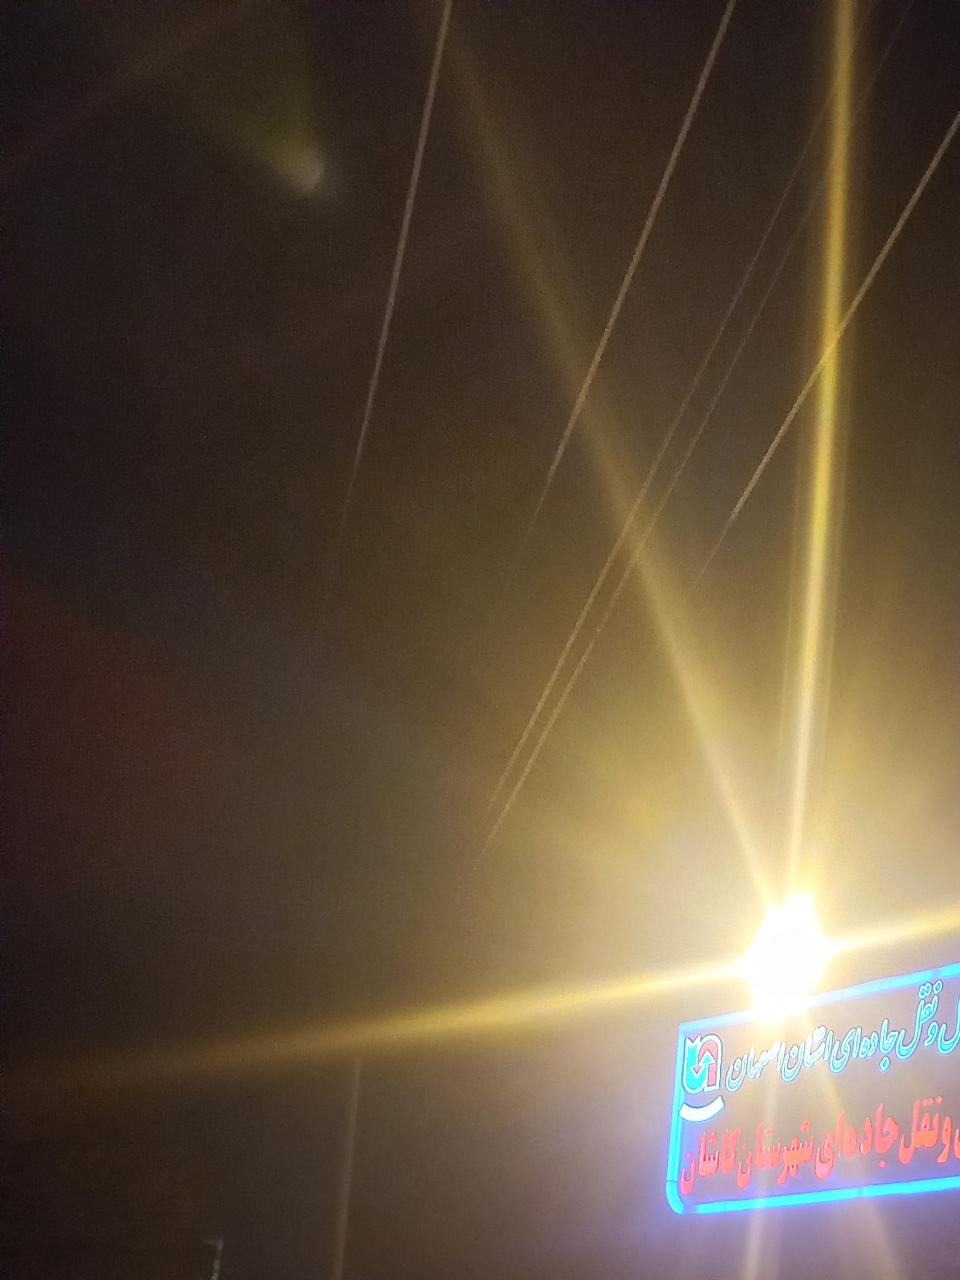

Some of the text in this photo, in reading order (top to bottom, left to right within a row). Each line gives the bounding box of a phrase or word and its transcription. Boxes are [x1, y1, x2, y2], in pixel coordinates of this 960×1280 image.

[896, 980, 943, 1060] نقل
[923, 1021, 939, 1047] و
[898, 1095, 944, 1165] نقل
[936, 1115, 952, 1164] و
